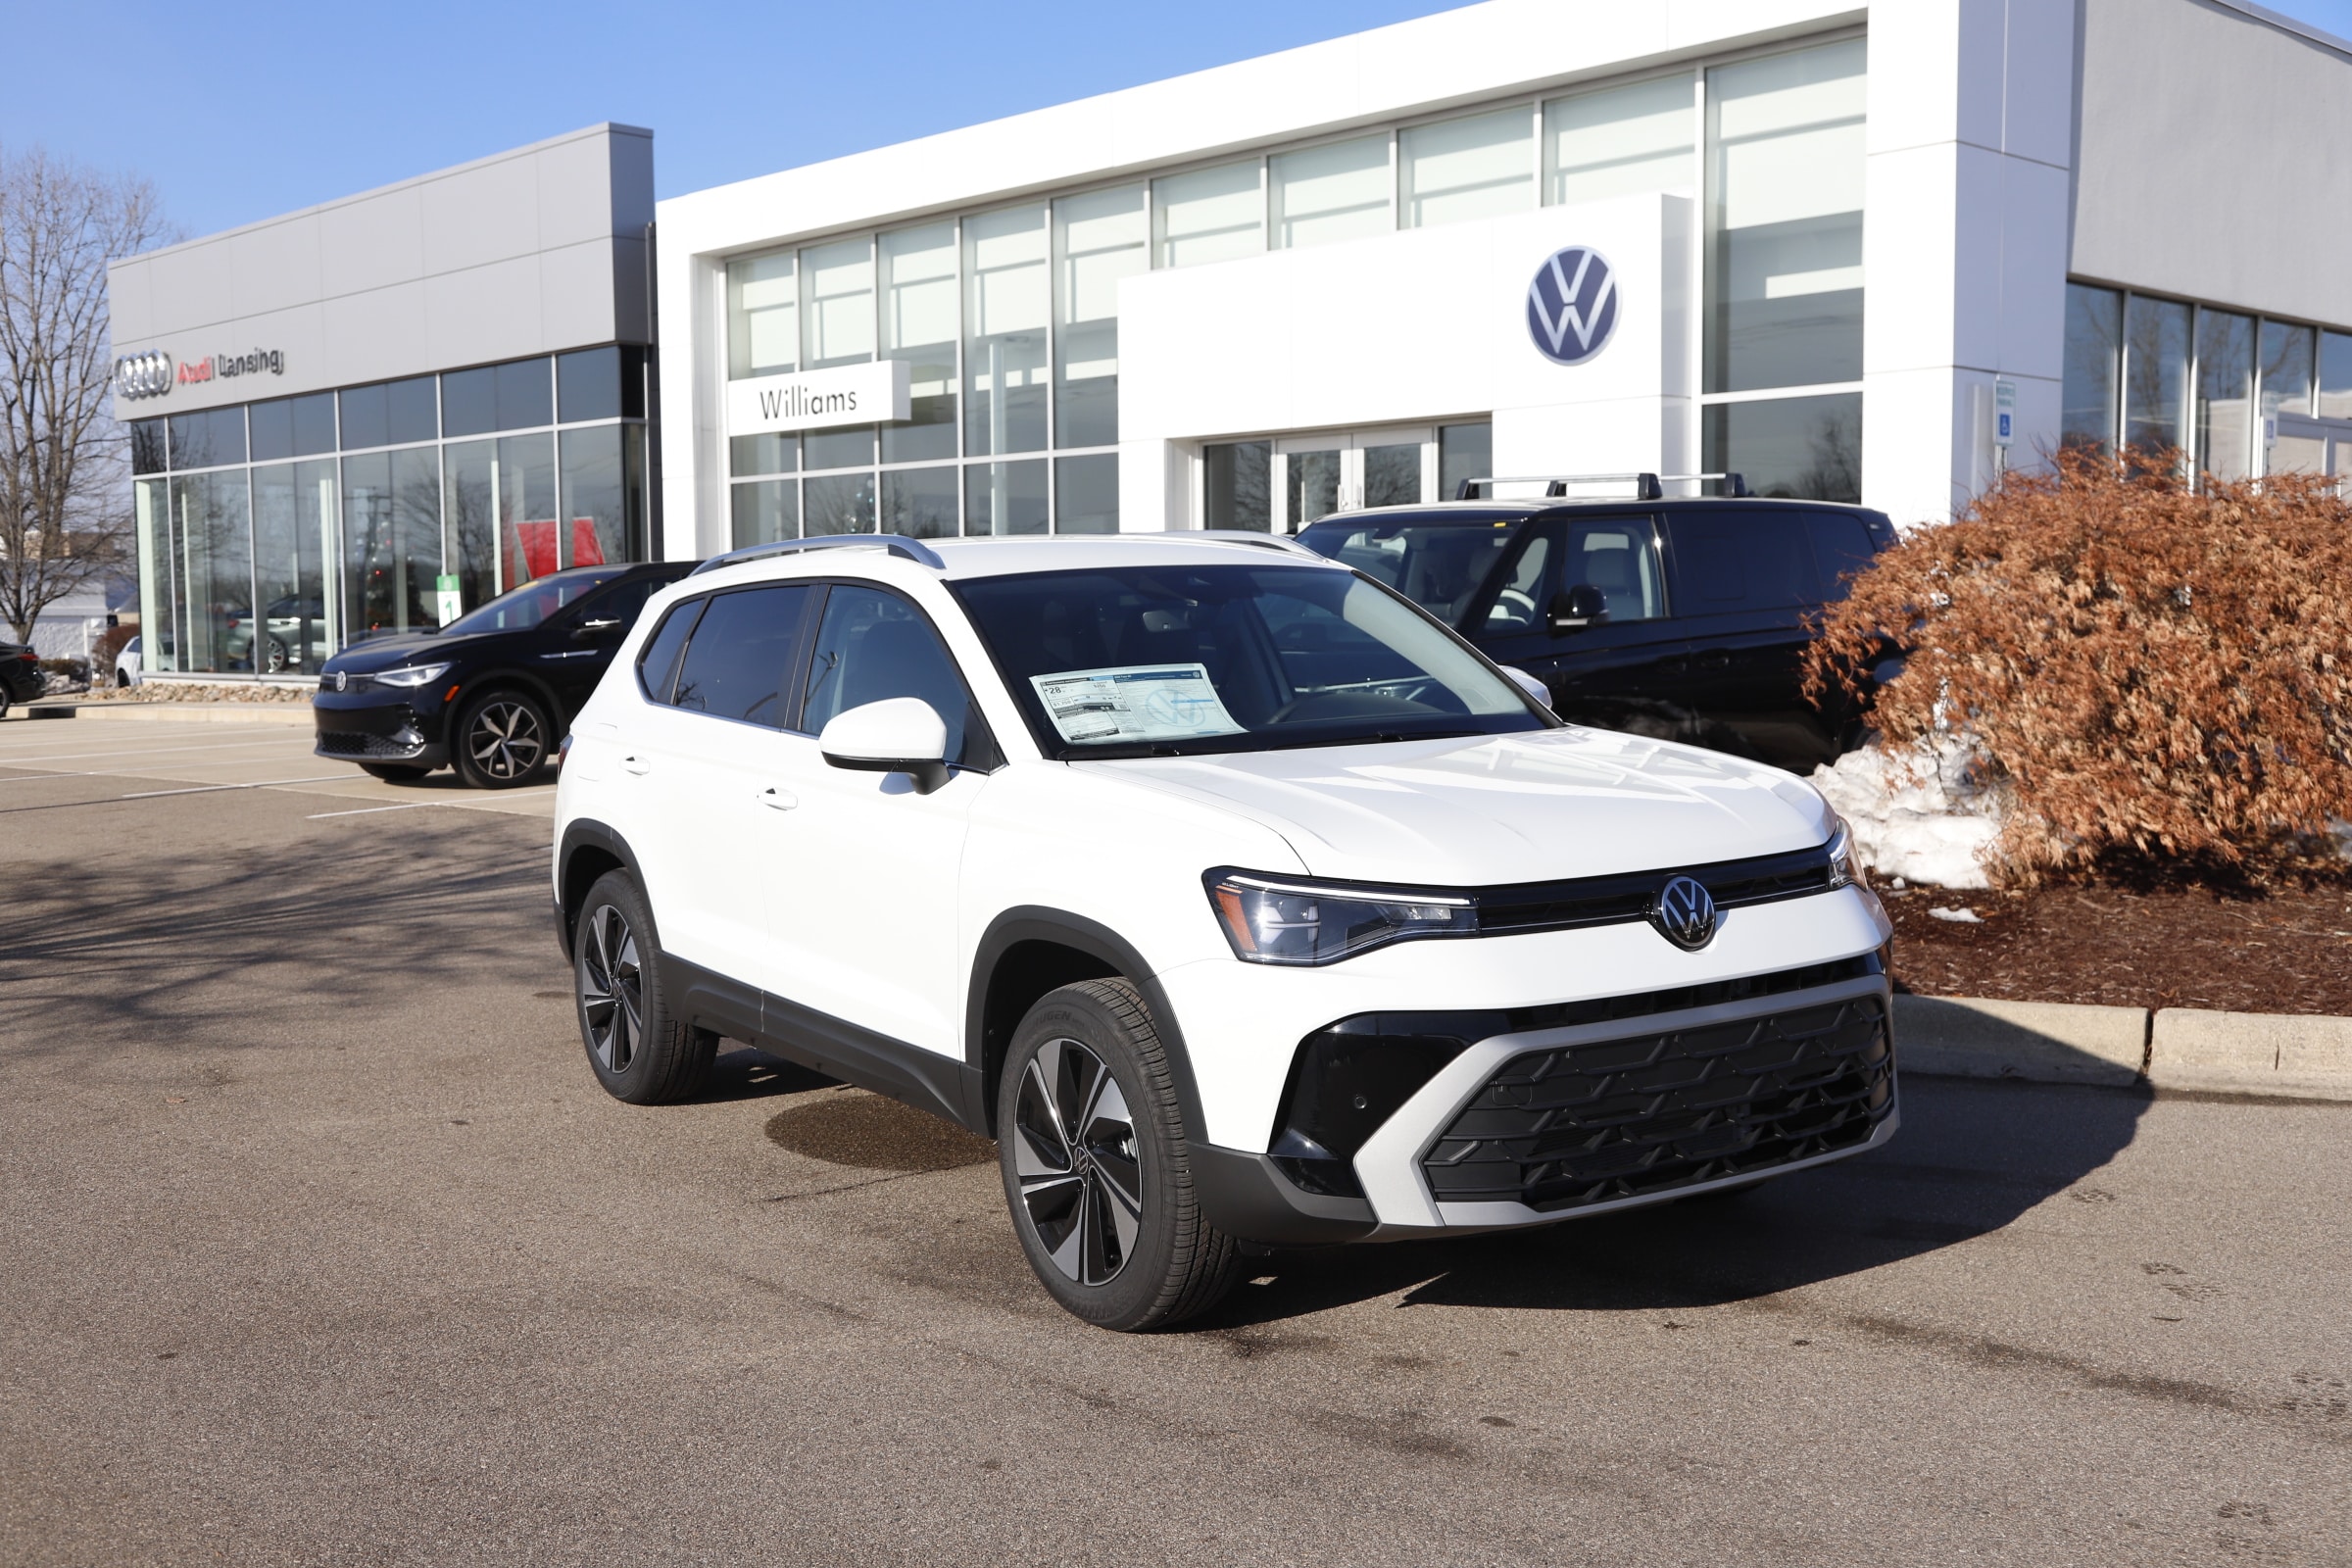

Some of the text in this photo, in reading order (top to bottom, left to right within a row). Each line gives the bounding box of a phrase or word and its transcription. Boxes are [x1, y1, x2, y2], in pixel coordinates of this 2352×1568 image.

[177, 347, 284, 385] Audi Lansing
[760, 385, 858, 419] Williams
[1049, 686, 1061, 695] 28
[1662, 876, 1714, 947] VW
